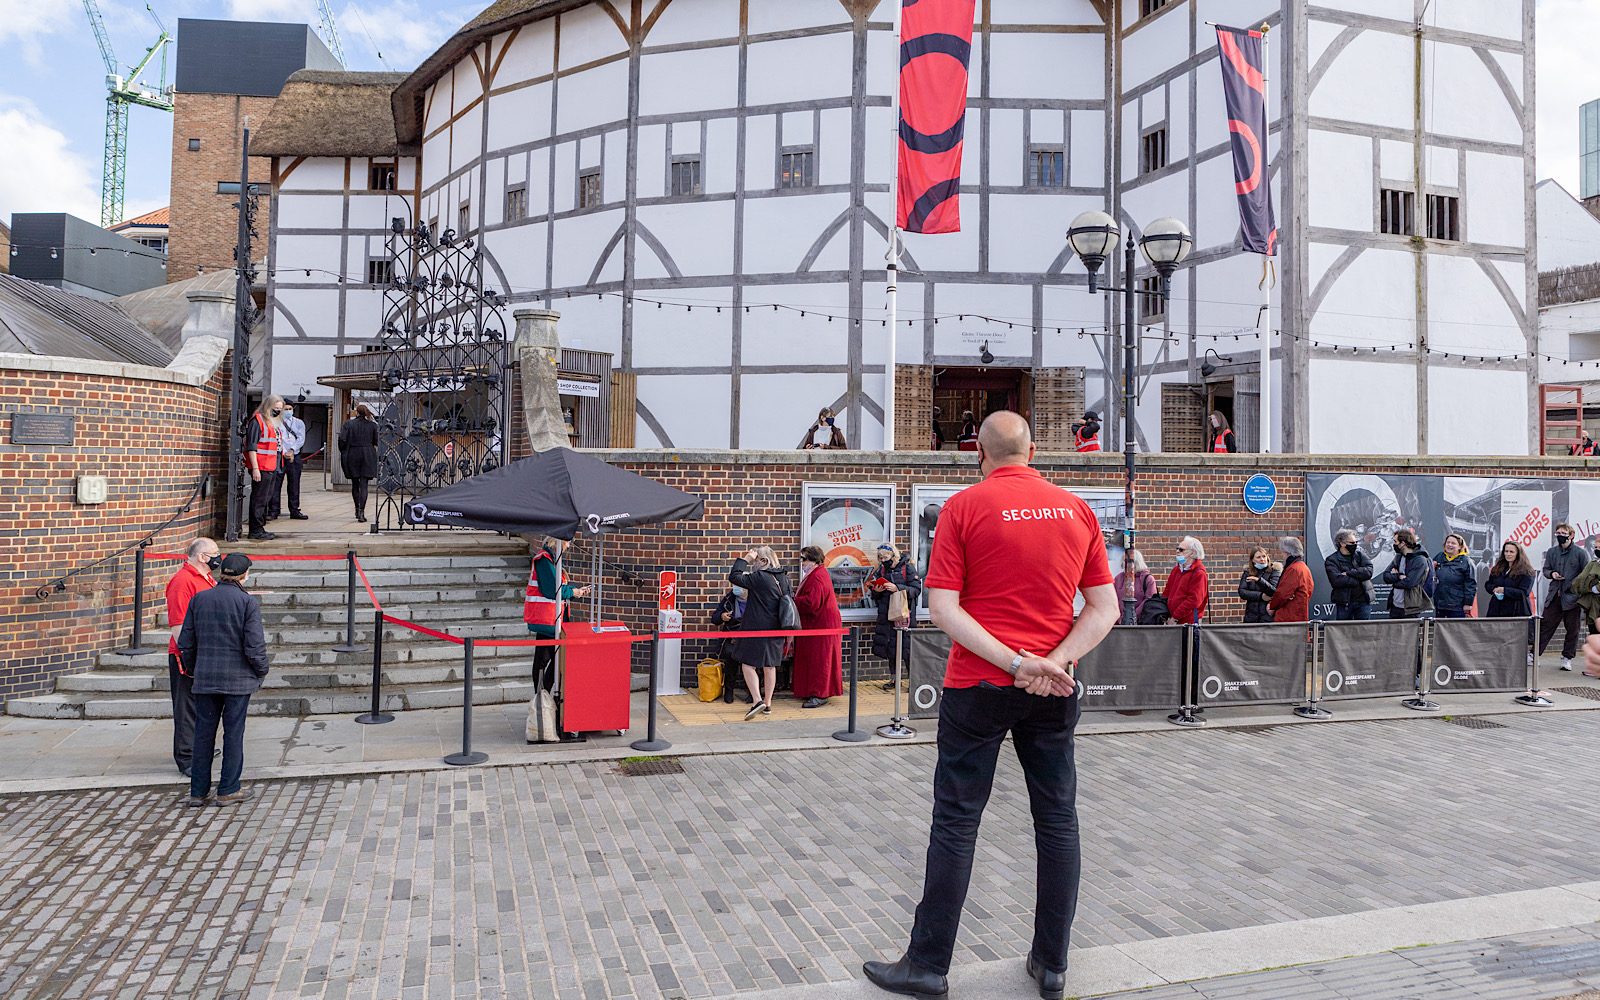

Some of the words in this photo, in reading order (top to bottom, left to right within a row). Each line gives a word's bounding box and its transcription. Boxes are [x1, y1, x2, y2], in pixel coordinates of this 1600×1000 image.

[1001, 507, 1074, 522] SECURITY
[827, 524, 863, 539] SUMMER
[1518, 513, 1551, 548] OURS
[832, 532, 862, 547] 2021
